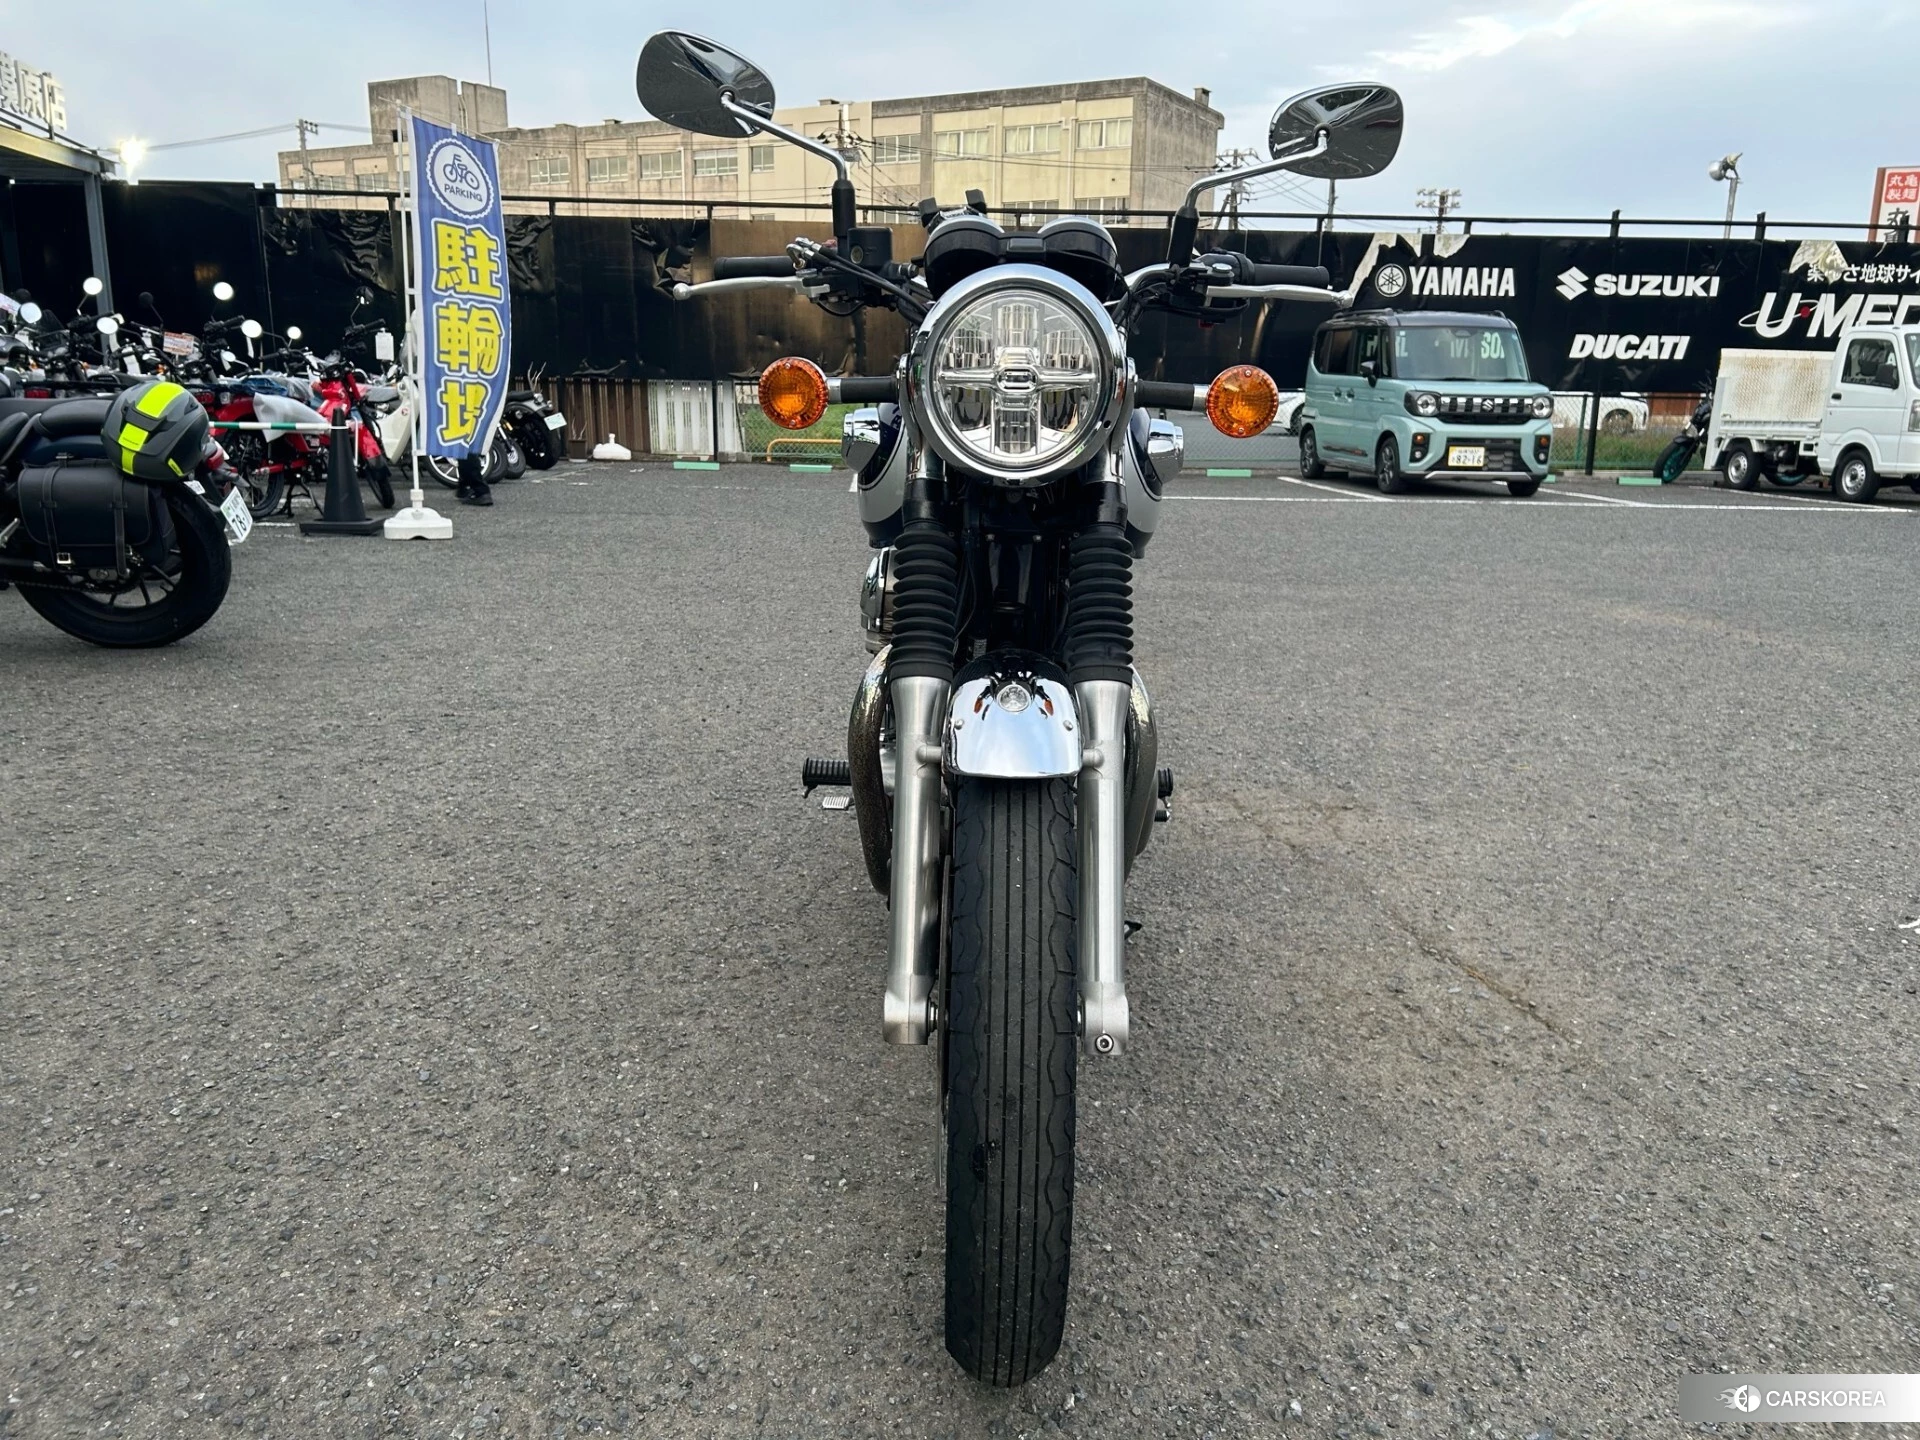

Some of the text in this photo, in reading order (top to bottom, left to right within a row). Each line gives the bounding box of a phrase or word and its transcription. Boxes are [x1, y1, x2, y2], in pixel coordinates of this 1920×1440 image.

[444, 183, 483, 202] PARKING
[1409, 266, 1516, 297] YAMAHA
[1594, 274, 1720, 297] SUZUKI
[1569, 333, 1690, 360] DUCATI
